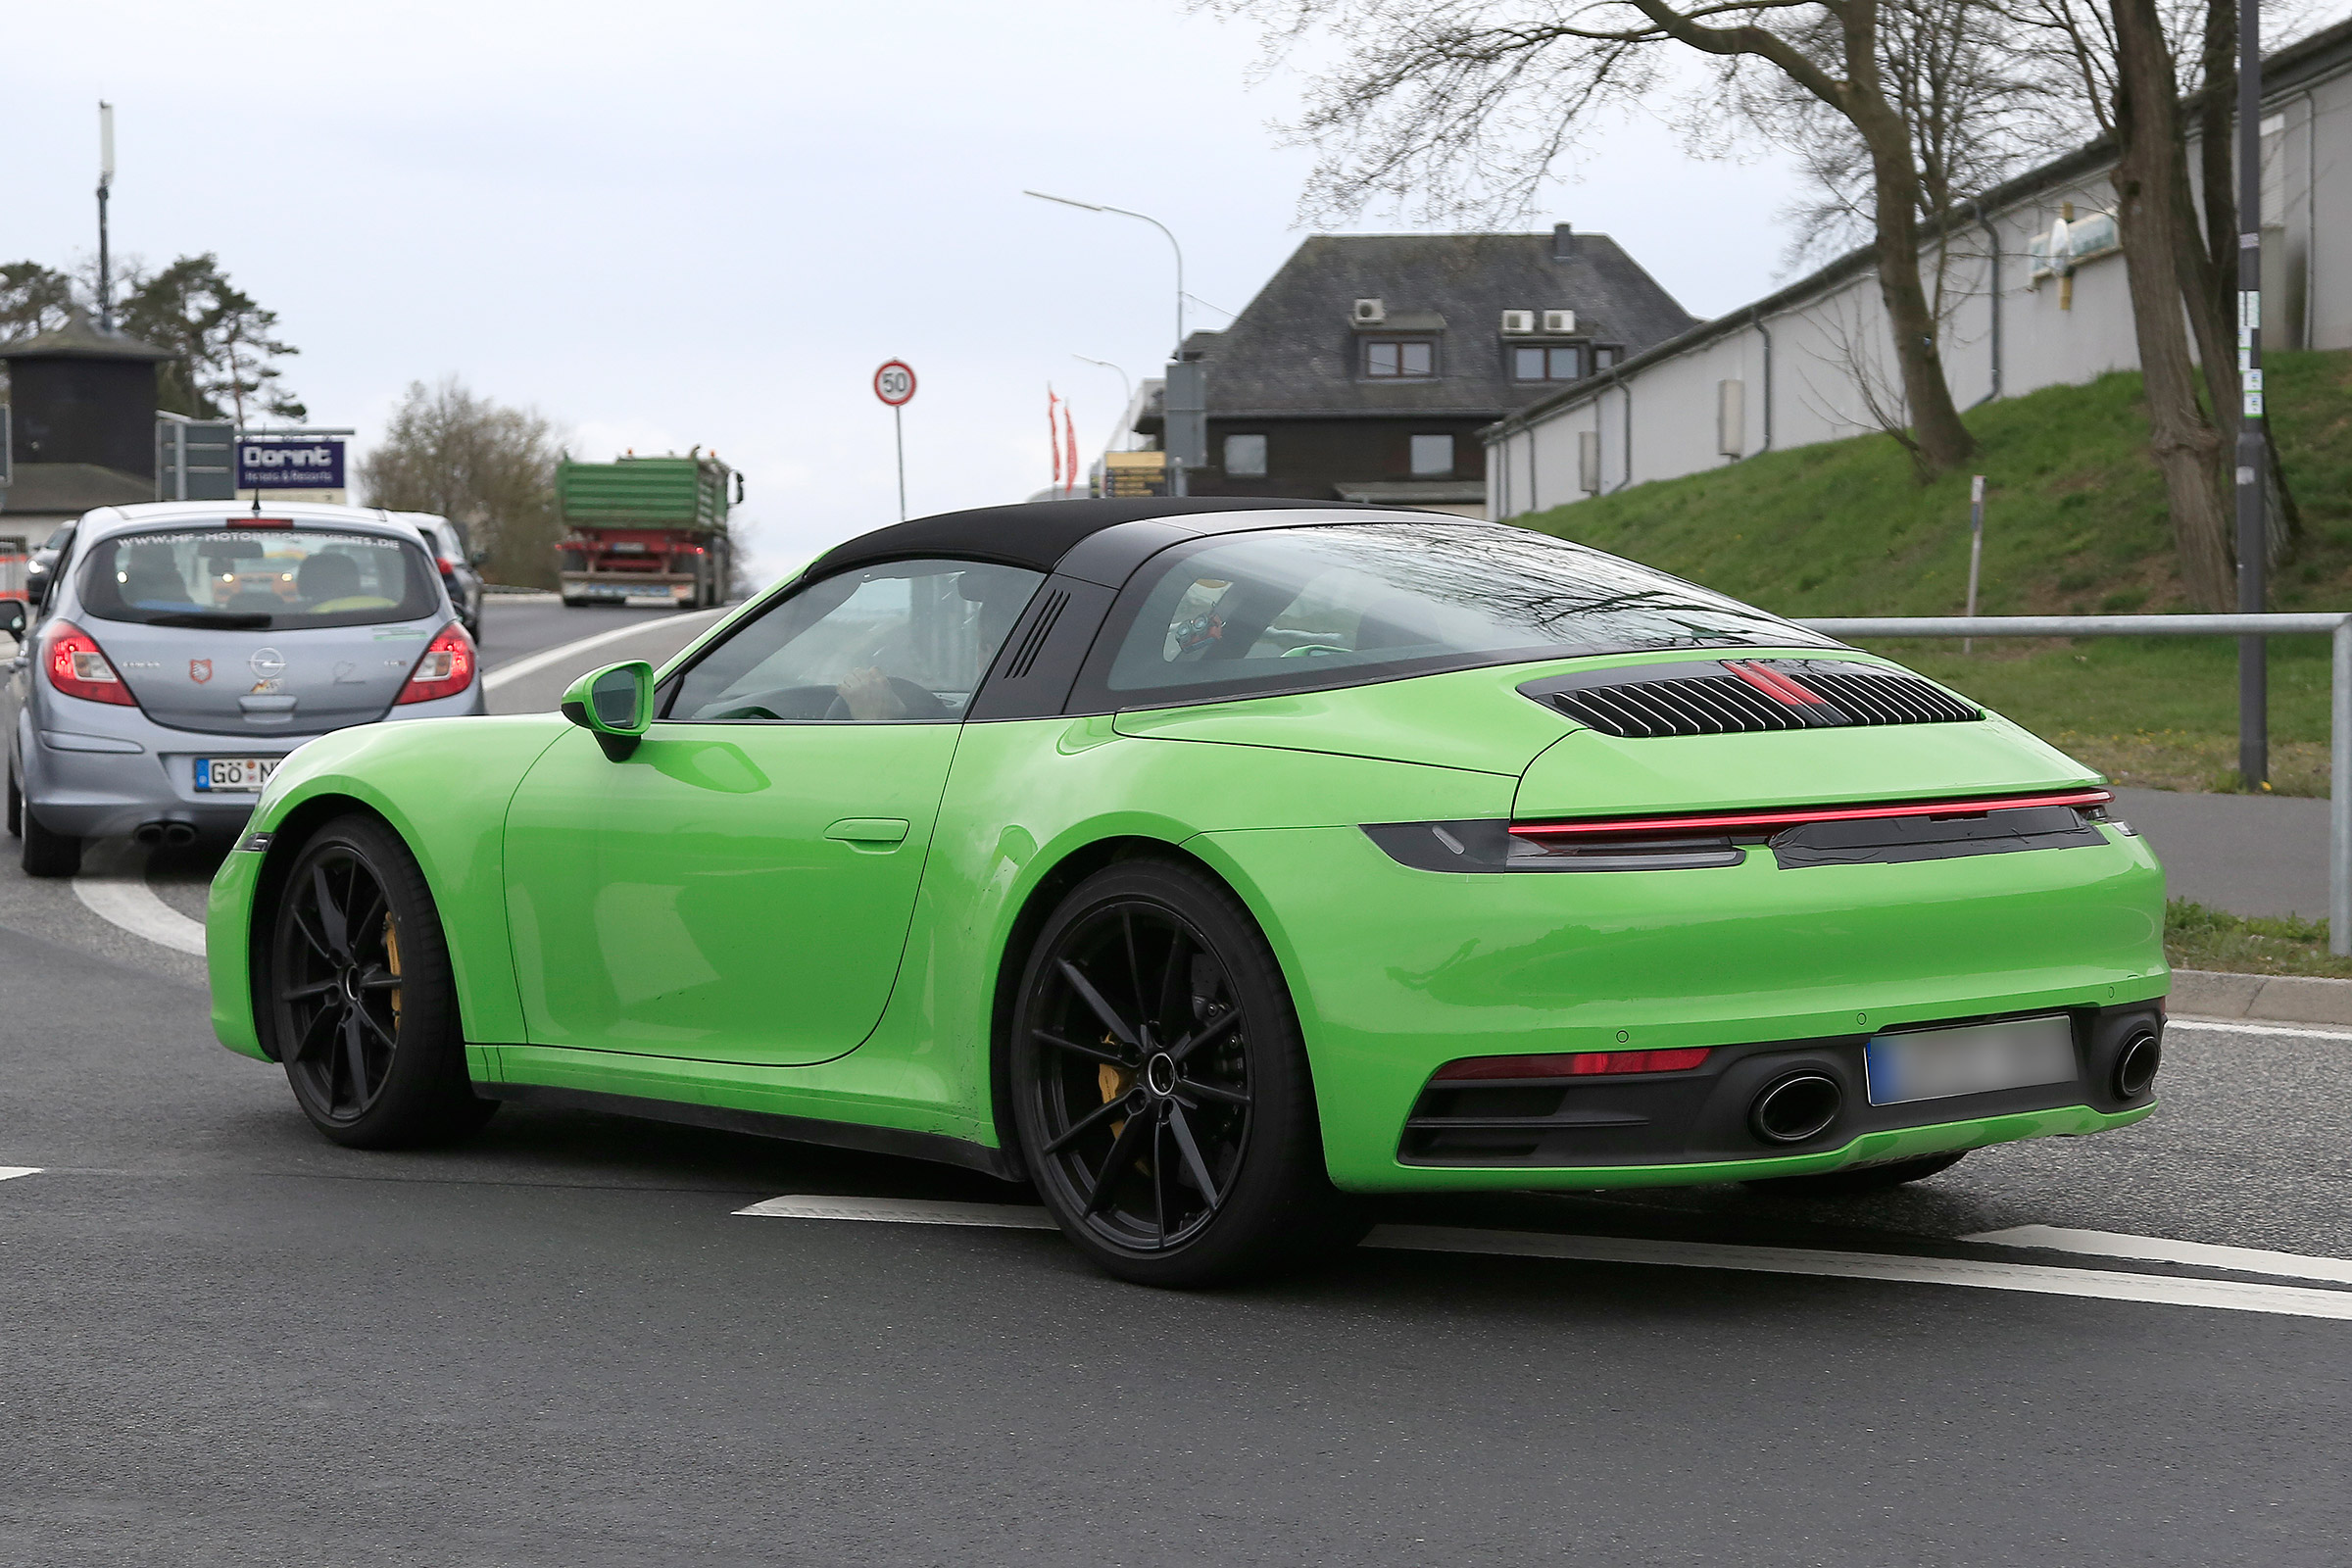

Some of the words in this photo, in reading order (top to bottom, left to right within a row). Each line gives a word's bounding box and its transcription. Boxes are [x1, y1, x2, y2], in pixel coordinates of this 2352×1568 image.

[883, 372, 907, 392] 50
[243, 446, 332, 466] Dorint
[212, 762, 242, 783] GÖ
